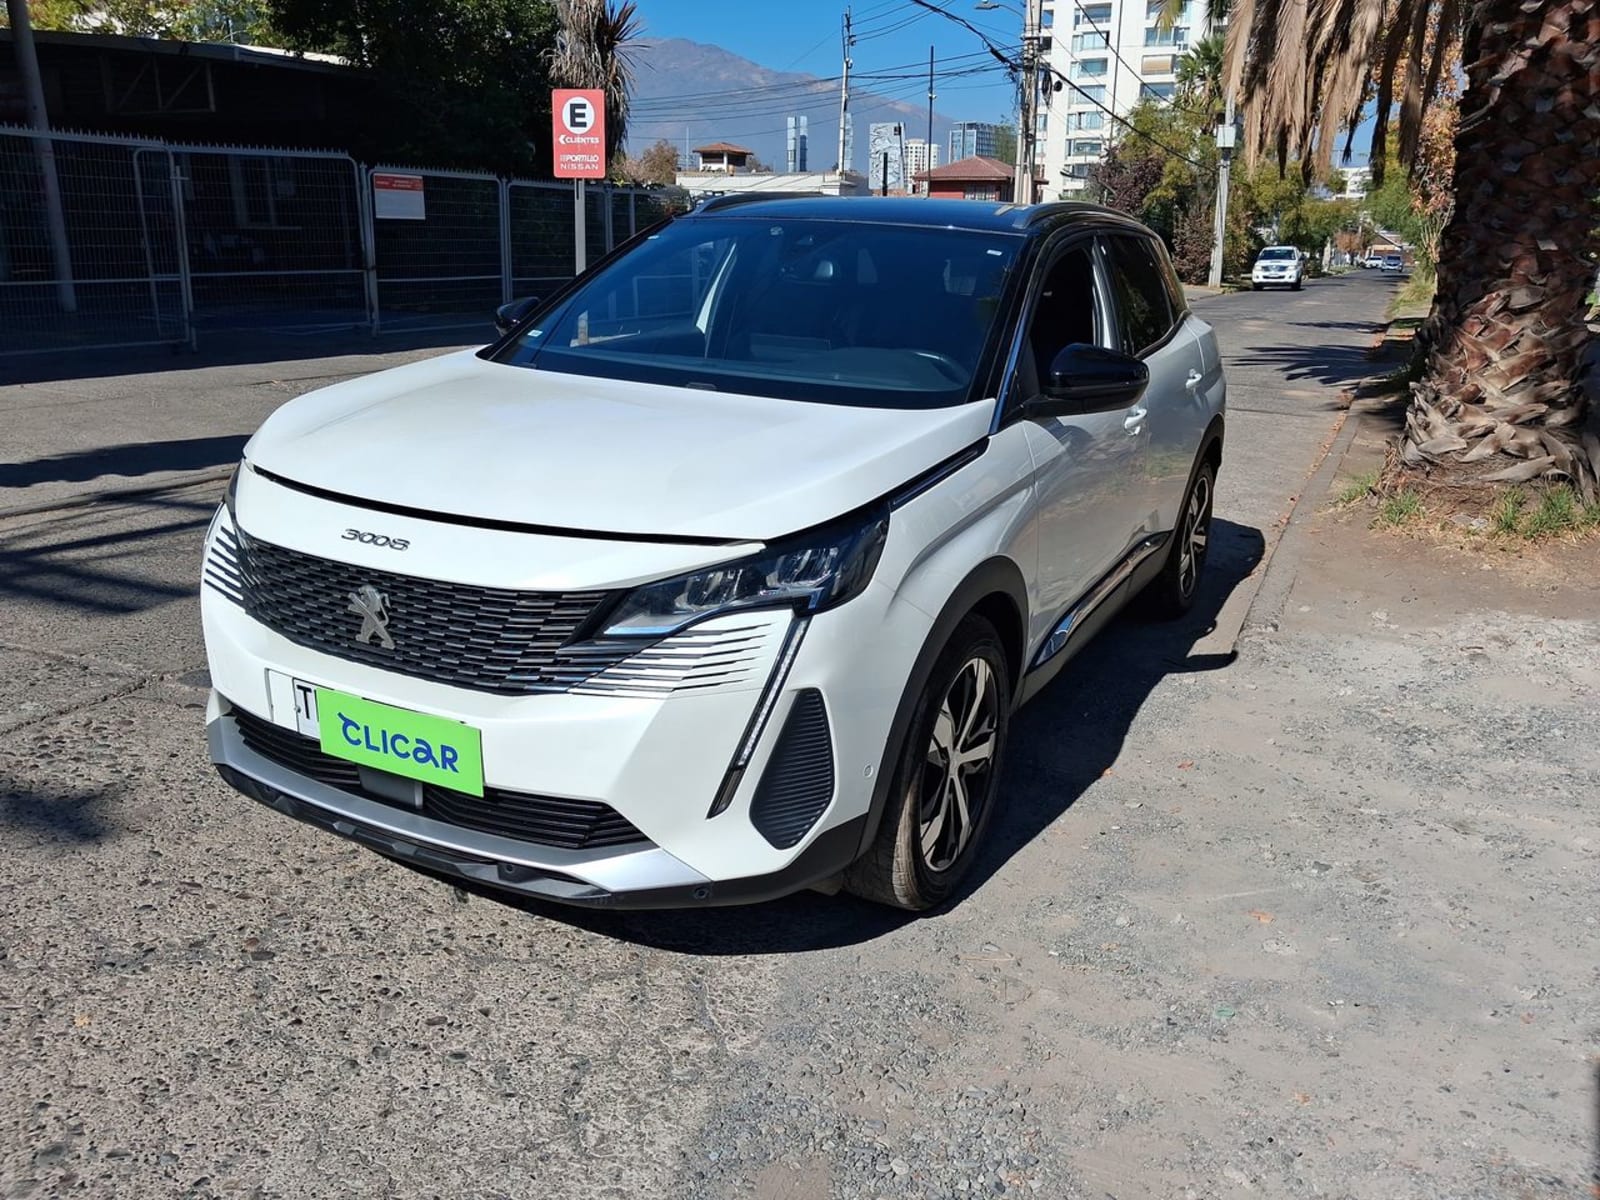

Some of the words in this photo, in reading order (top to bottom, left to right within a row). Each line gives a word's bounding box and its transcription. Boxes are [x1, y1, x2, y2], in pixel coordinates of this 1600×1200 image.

[569, 103, 587, 128] E
[565, 136, 600, 144] CLIENTES
[566, 154, 600, 162] PORTILLO
[341, 528, 411, 551] 3008
[296, 684, 319, 722] T
